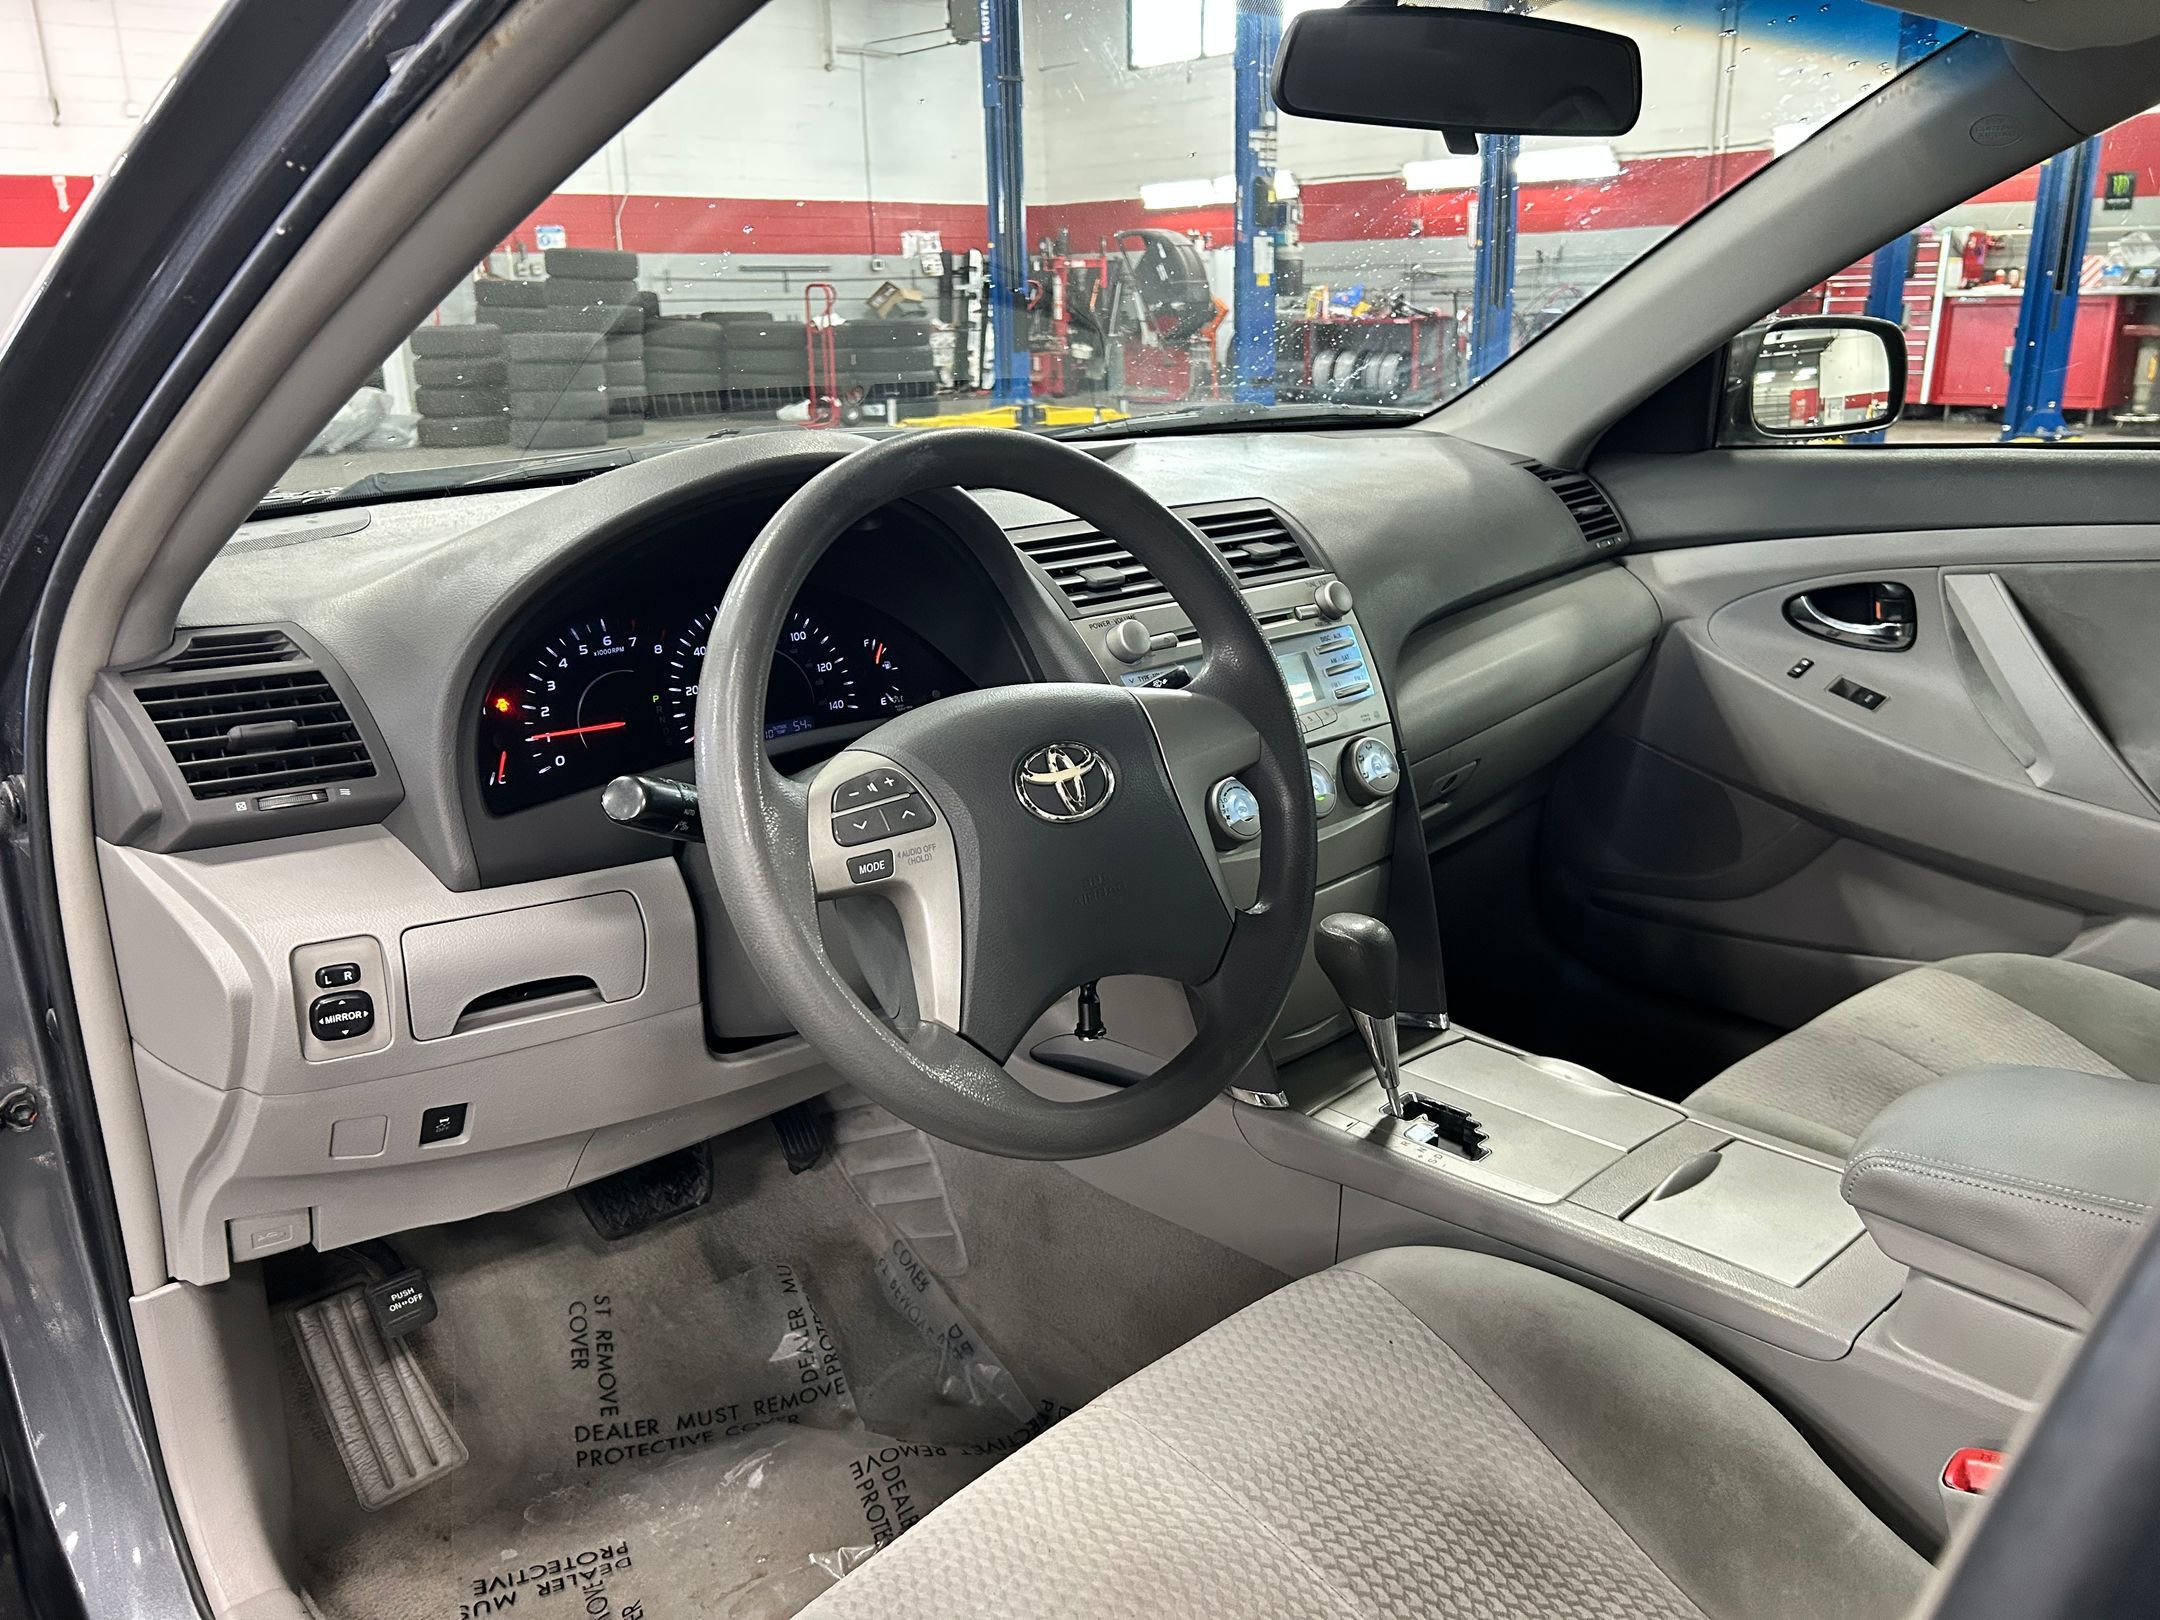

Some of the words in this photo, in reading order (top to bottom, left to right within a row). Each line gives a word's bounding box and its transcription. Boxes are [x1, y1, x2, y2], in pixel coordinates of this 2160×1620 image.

[1089, 619, 1111, 630] POWER
[602, 636, 612, 646] 6
[628, 637, 637, 647] 7
[790, 631, 807, 642] 100
[863, 639, 870, 648] F
[579, 645, 588, 655] 5
[654, 645, 663, 654] 8
[694, 647, 707, 657] 40
[558, 658, 568, 668] 4
[816, 662, 833, 673] 120
[547, 681, 556, 691] 3
[685, 685, 699, 696] 20
[652, 695, 660, 703] P
[880, 697, 888, 706] E
[829, 700, 844, 711] 140
[541, 706, 550, 717] 2
[555, 756, 565, 767] 0
[902, 846, 922, 859] AUDIO
[923, 843, 937, 853] OFF
[907, 853, 933, 866] (HOLD)
[858, 860, 886, 875] MODE
[324, 975, 332, 985] L
[343, 971, 353, 982] R
[324, 1009, 363, 1025] MIRROR
[391, 1287, 415, 1302] PUSH
[389, 1301, 402, 1313] ON
[408, 1293, 424, 1305] OFF
[569, 1301, 589, 1370] COVER
[787, 1306, 819, 1384] DEALER
[596, 1329, 620, 1417] REMOVE
[575, 1418, 659, 1443] DEALER
[676, 1404, 740, 1431] MUST
[754, 1376, 847, 1416] REMOVE
[576, 1430, 713, 1468] PROTECTIVE
[473, 1541, 629, 1596] PROTECTIVE
[536, 1556, 633, 1597] DEALER
